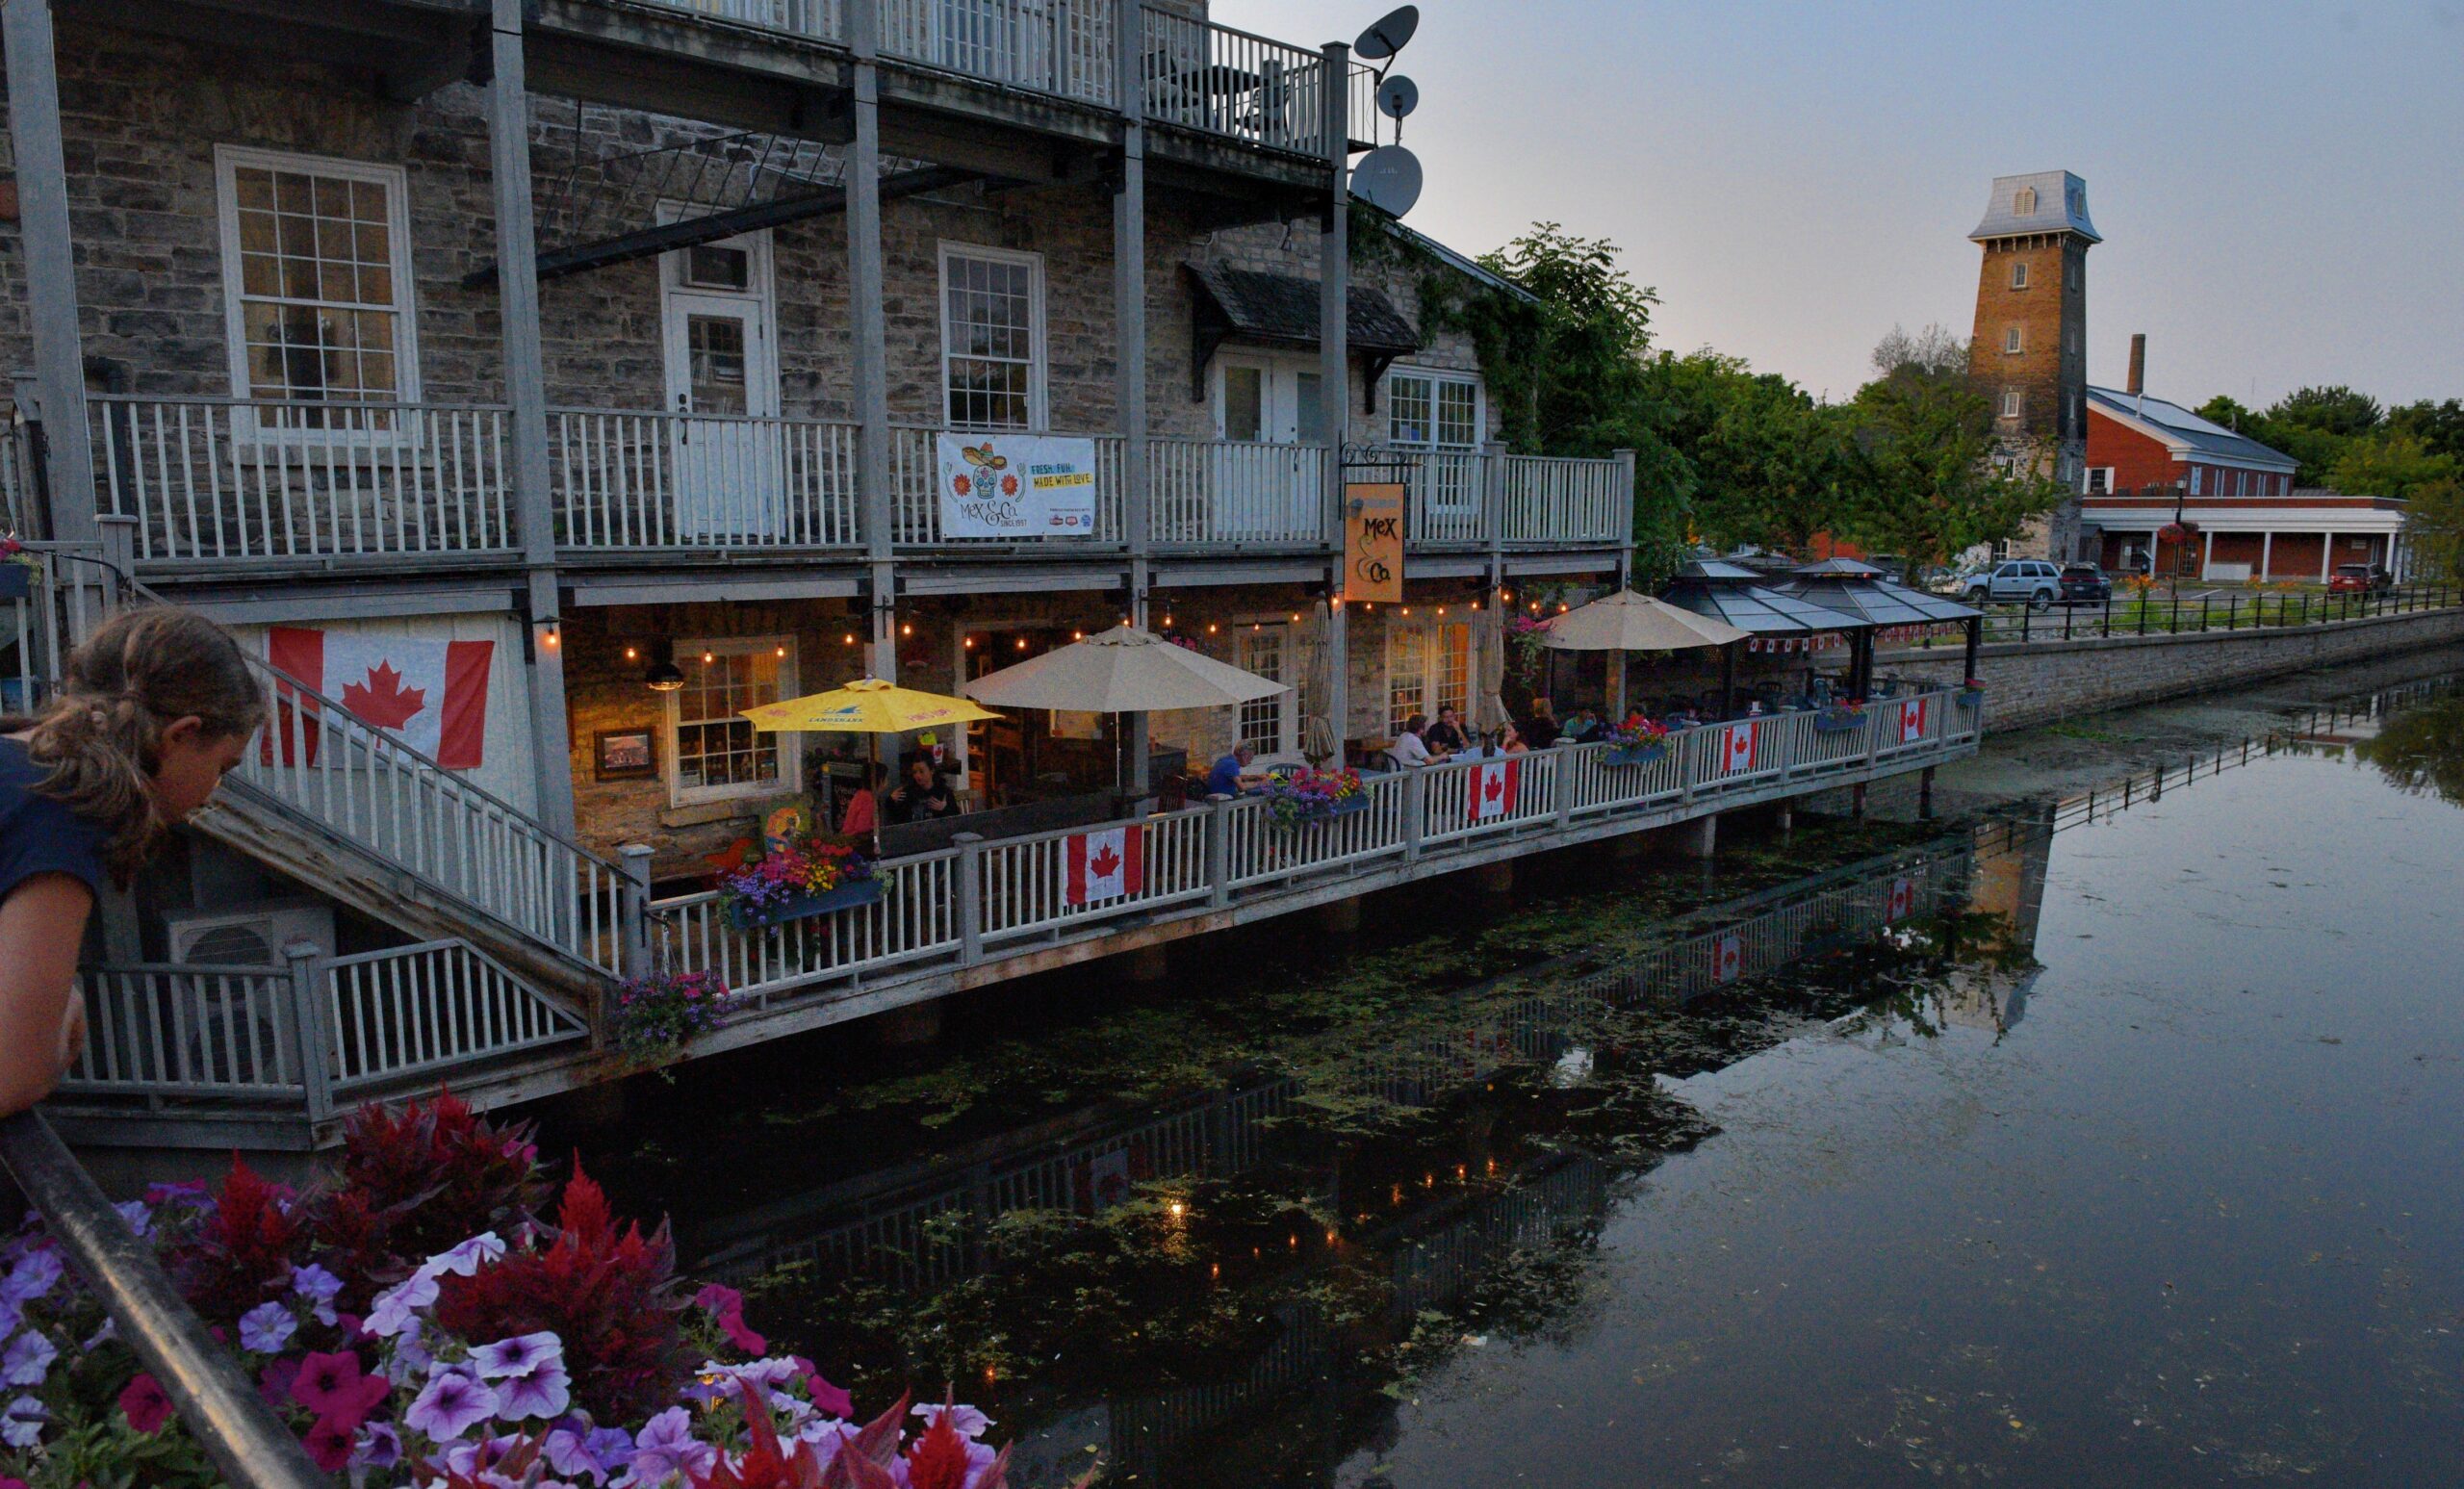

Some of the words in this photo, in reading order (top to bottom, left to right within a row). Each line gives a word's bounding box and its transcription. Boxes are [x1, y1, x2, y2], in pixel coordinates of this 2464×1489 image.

[1034, 475, 1054, 488] MADE
[1055, 475, 1072, 485] WITH
[986, 500, 1001, 526] &
[1370, 562, 1391, 583] Co.
